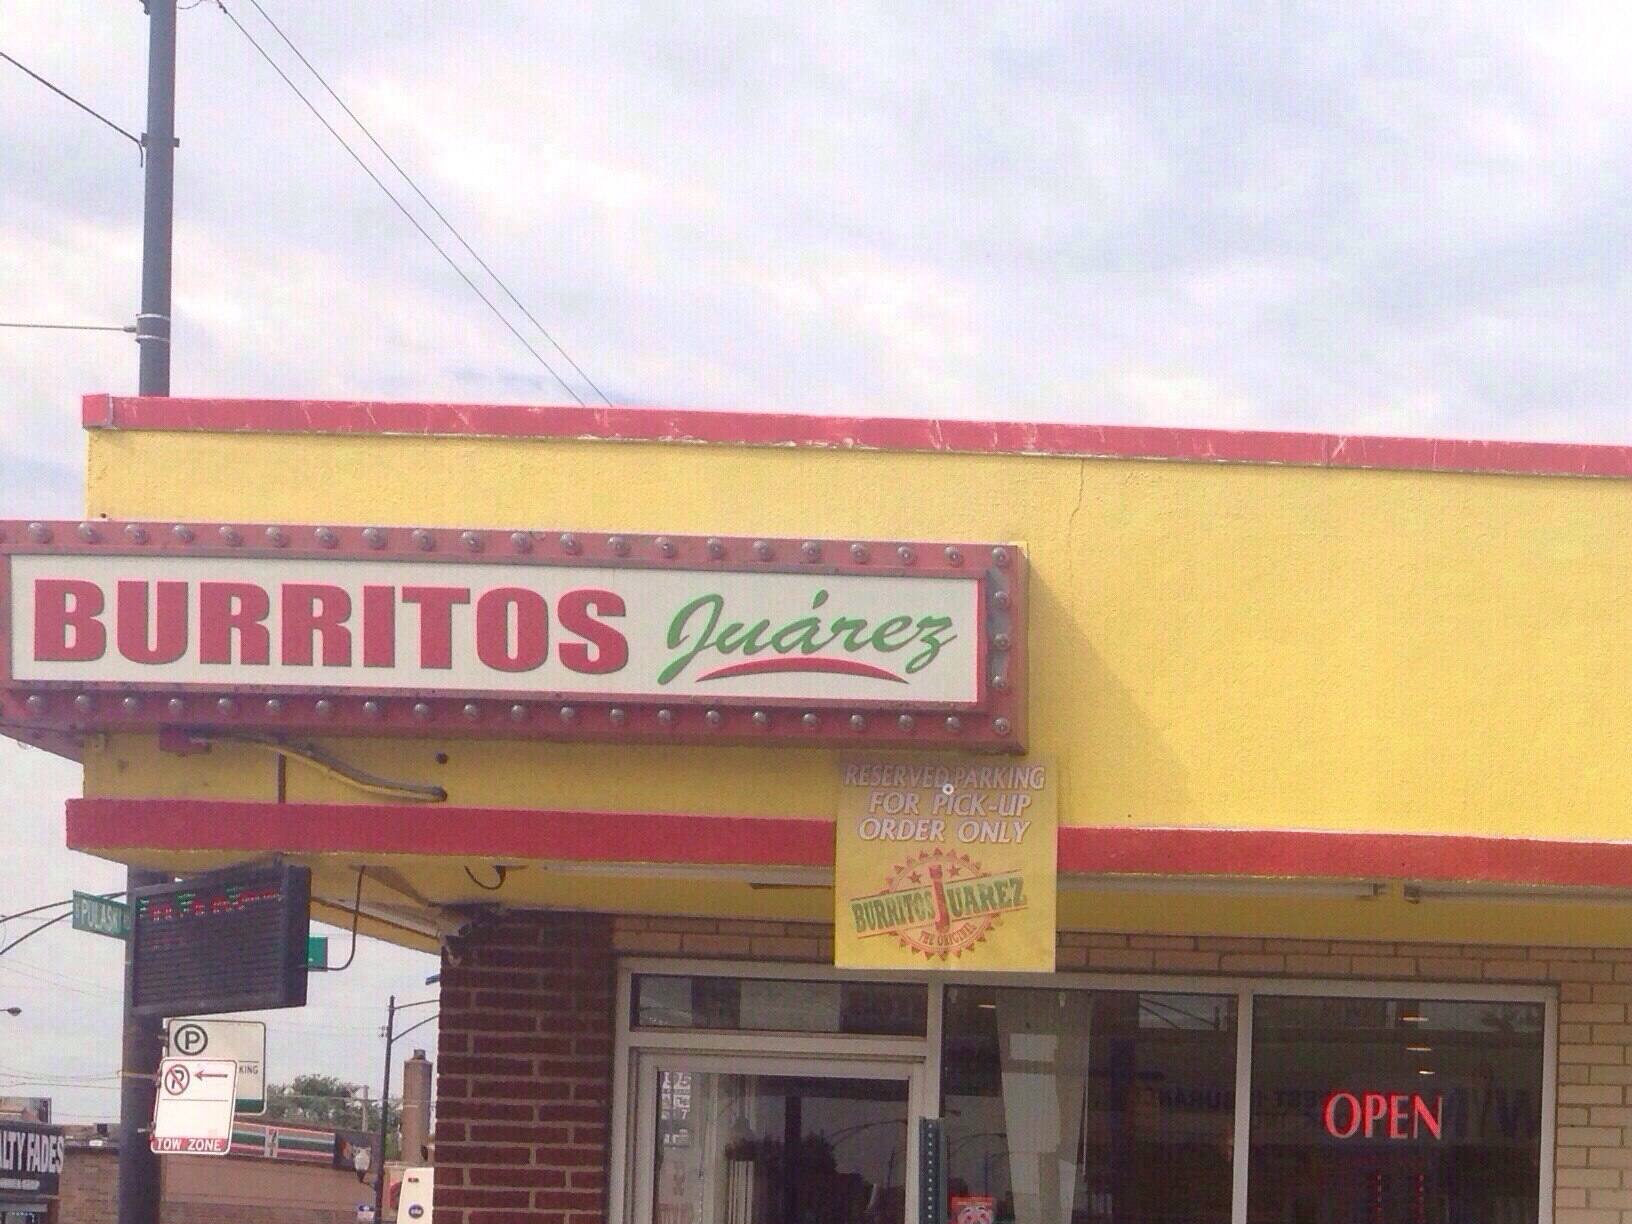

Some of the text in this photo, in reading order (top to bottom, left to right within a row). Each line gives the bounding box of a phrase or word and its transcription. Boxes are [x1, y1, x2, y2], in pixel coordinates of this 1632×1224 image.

[34, 579, 957, 685] BURRITOS Juárez
[844, 765, 1045, 790] RESERVED PARKING
[869, 791, 1032, 817] FOR PICK-UP
[859, 817, 1031, 844] ORDER ONLY
[851, 889, 935, 933] BURRITOS
[239, 1064, 259, 1075] KING
[1323, 1092, 1442, 1140] OPEN
[26, 1135, 64, 1174] FADES
[156, 1138, 222, 1152] TOW ZONE
